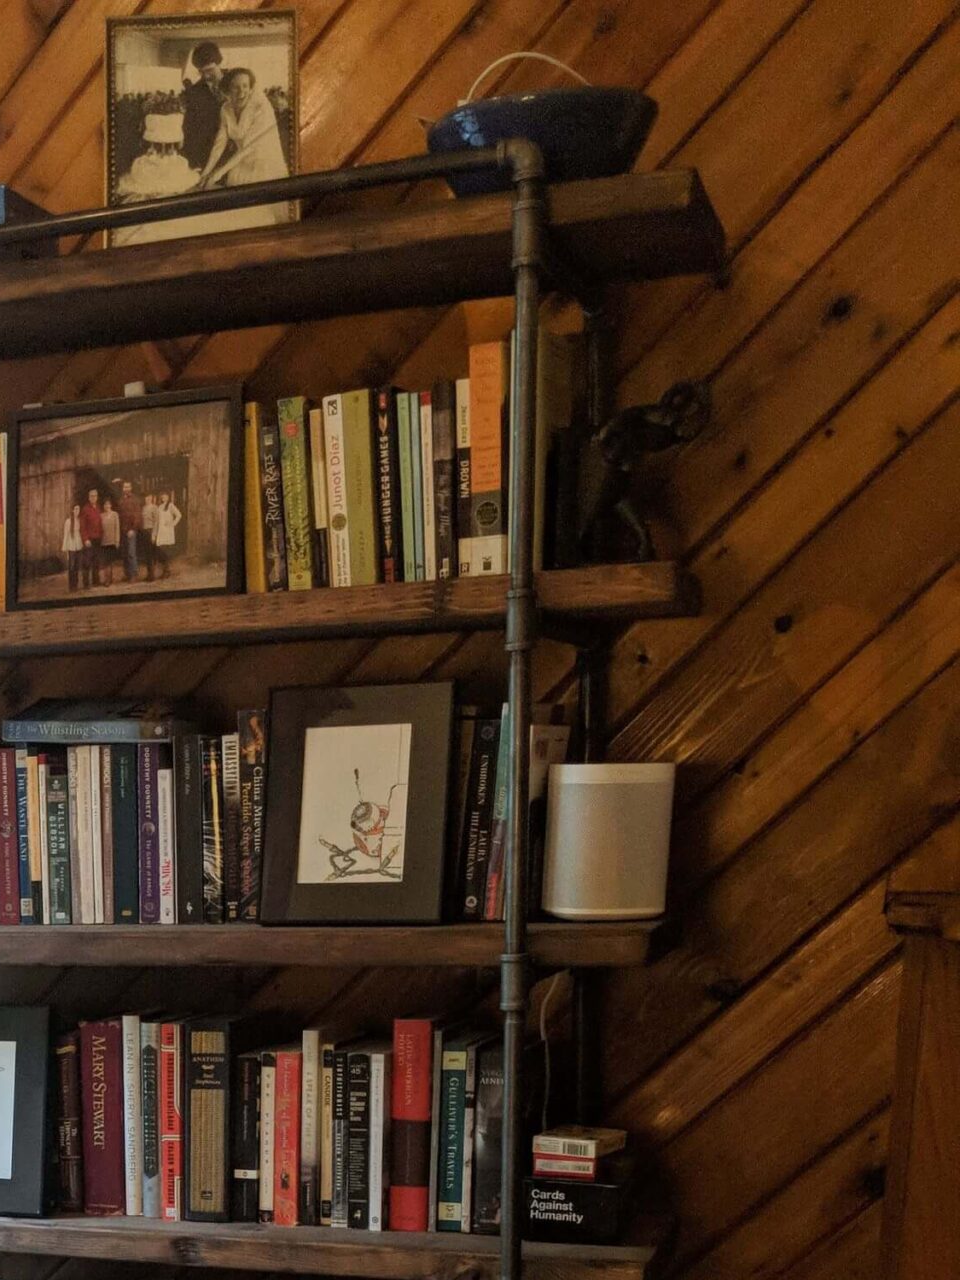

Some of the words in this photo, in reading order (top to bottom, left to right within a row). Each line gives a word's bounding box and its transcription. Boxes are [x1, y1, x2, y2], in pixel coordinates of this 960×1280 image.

[263, 454, 277, 486] RATS
[380, 436, 391, 473] GAMES
[331, 472, 343, 511] Junot
[460, 460, 470, 498] DROWN
[266, 489, 280, 525] RIVER
[381, 475, 392, 523] HUNGER
[38, 724, 89, 737] Whistling
[91, 725, 127, 735] Season
[17, 773, 27, 792] THE
[143, 747, 151, 783] DOROTHY
[224, 740, 239, 798] EMBASSYTOWN
[253, 766, 263, 801] China
[477, 754, 488, 806] UNBROKEN
[18, 796, 28, 832] WASTE
[241, 782, 252, 823] Perdido
[50, 816, 59, 855] GIBSON
[57, 802, 66, 850] WILLIAM
[242, 826, 253, 856] Street
[20, 834, 29, 862] LAND
[466, 810, 480, 880] HILLENBRAND
[477, 829, 489, 862] LAURA
[162, 858, 172, 880] Mike
[242, 858, 253, 895] Station
[92, 1035, 107, 1081] MARY
[126, 1033, 135, 1061] LEAN
[126, 1064, 135, 1074] IN
[127, 1084, 136, 1121] SHERYL
[324, 1075, 332, 1107] CANDIDE
[447, 1077, 459, 1140] GULLIVER'S
[93, 1081, 108, 1148] STEWART
[128, 1126, 136, 1182] SANDBERG
[144, 1114, 156, 1170] THIEVES
[446, 1143, 458, 1190] TRAVELS
[530, 1199, 574, 1212] Against
[531, 1188, 566, 1201] Cards
[530, 1209, 584, 1225] Humanity
